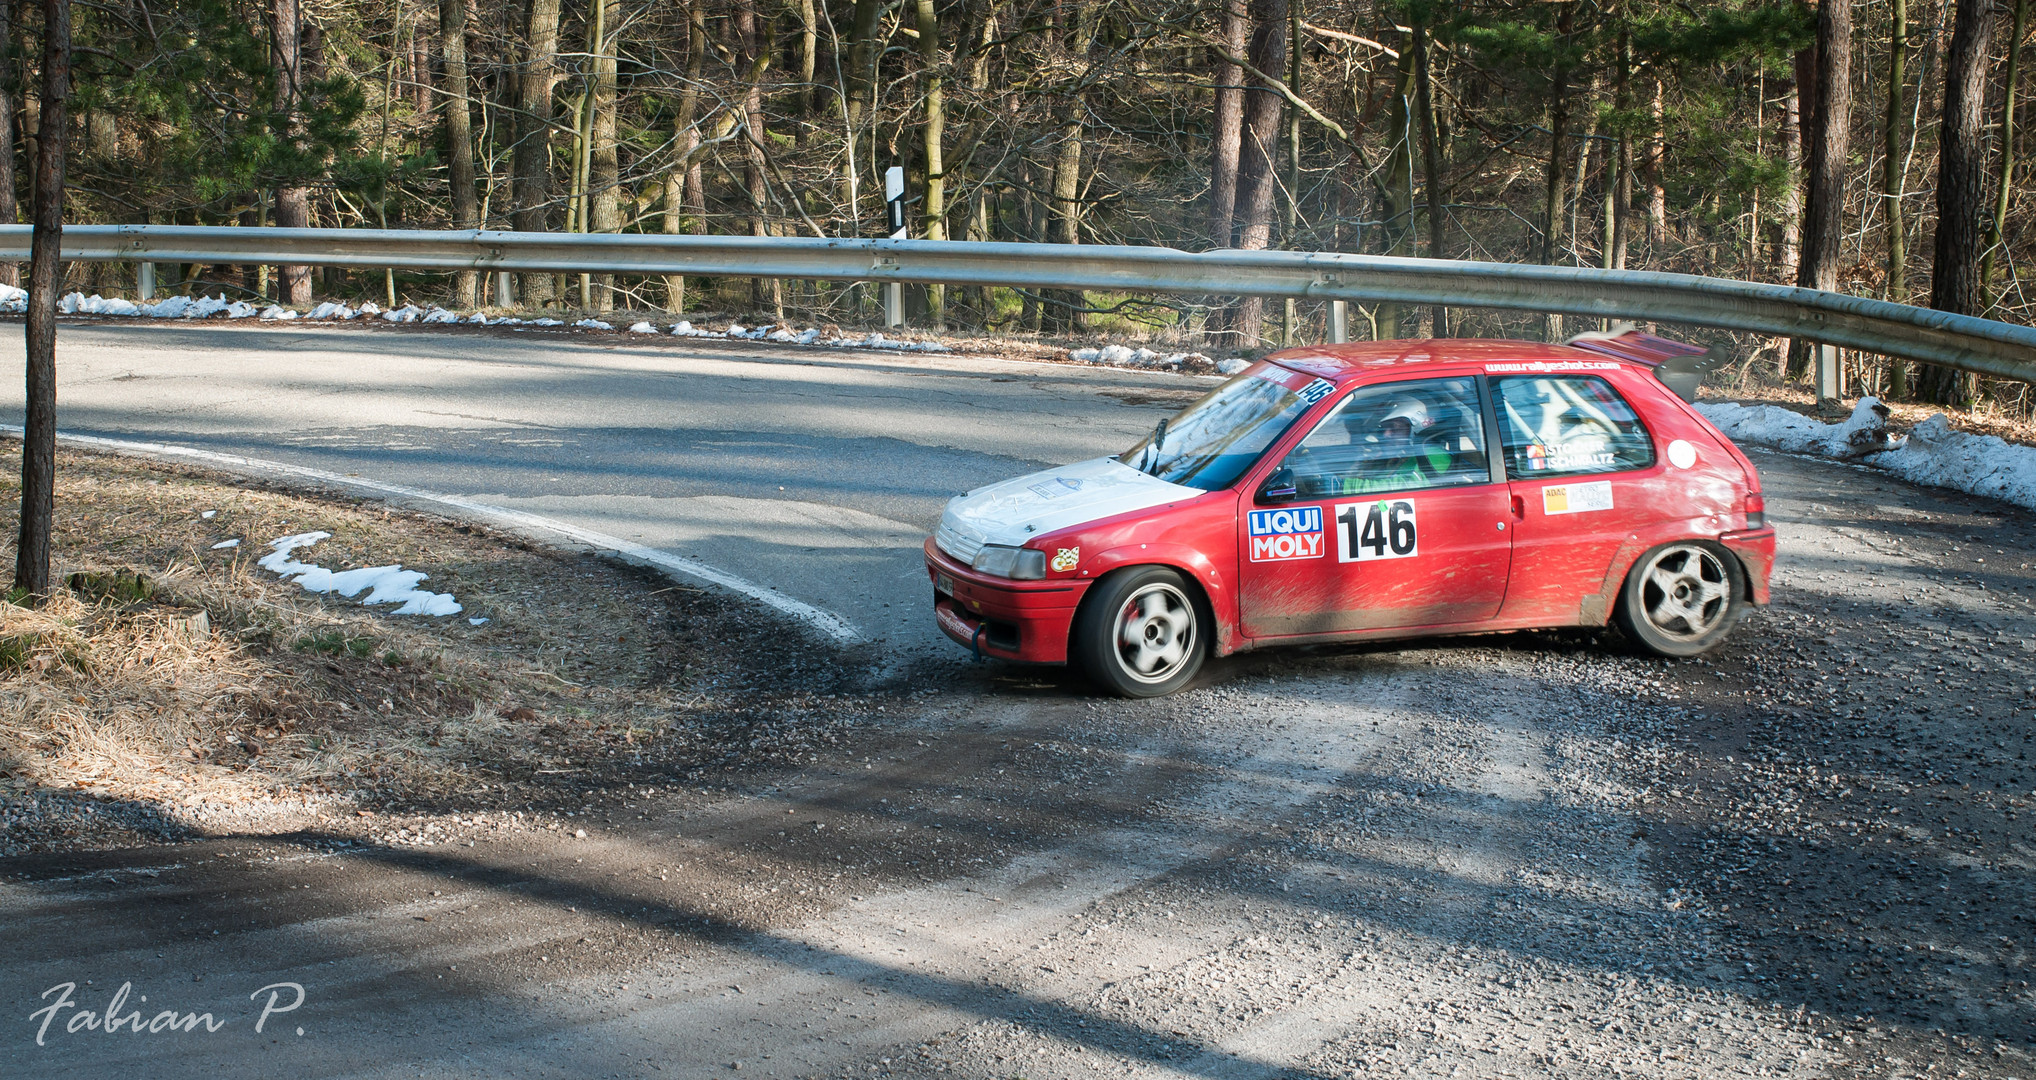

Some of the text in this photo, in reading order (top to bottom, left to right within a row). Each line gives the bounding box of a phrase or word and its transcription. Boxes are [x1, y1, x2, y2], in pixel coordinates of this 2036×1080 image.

[1485, 361, 1621, 372] www.rallyeshots.com
[1298, 379, 1334, 403] 146
[1546, 488, 1567, 497] ADAC
[1251, 509, 1320, 534] LIQUI
[1337, 501, 1416, 560] 146
[1254, 533, 1322, 559] MOLY
